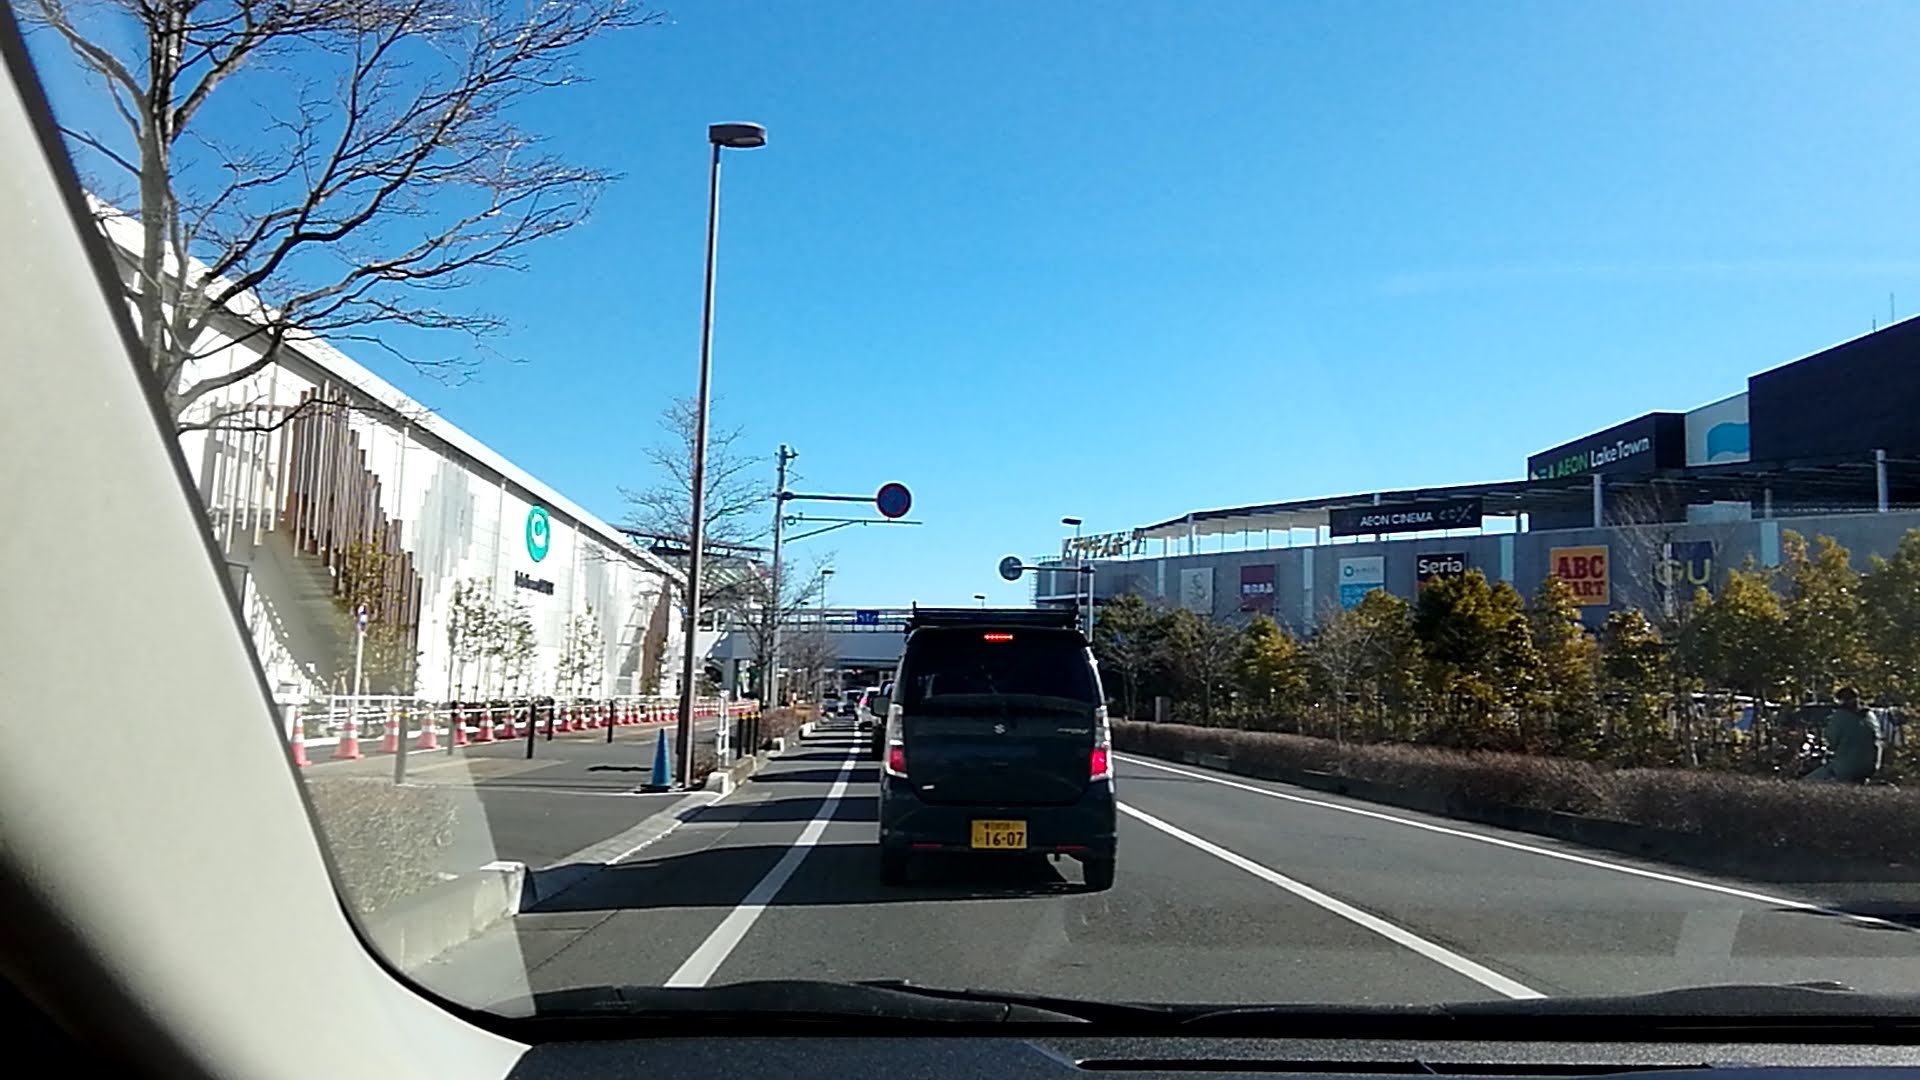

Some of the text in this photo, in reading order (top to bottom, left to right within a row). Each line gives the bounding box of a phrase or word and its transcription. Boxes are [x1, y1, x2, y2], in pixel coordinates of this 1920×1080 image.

[1360, 515, 1389, 527] AEON
[1391, 512, 1434, 525] CINEMA
[1419, 557, 1464, 574] Seria
[1558, 555, 1604, 580] ABC
[985, 831, 1025, 847] 16-07
